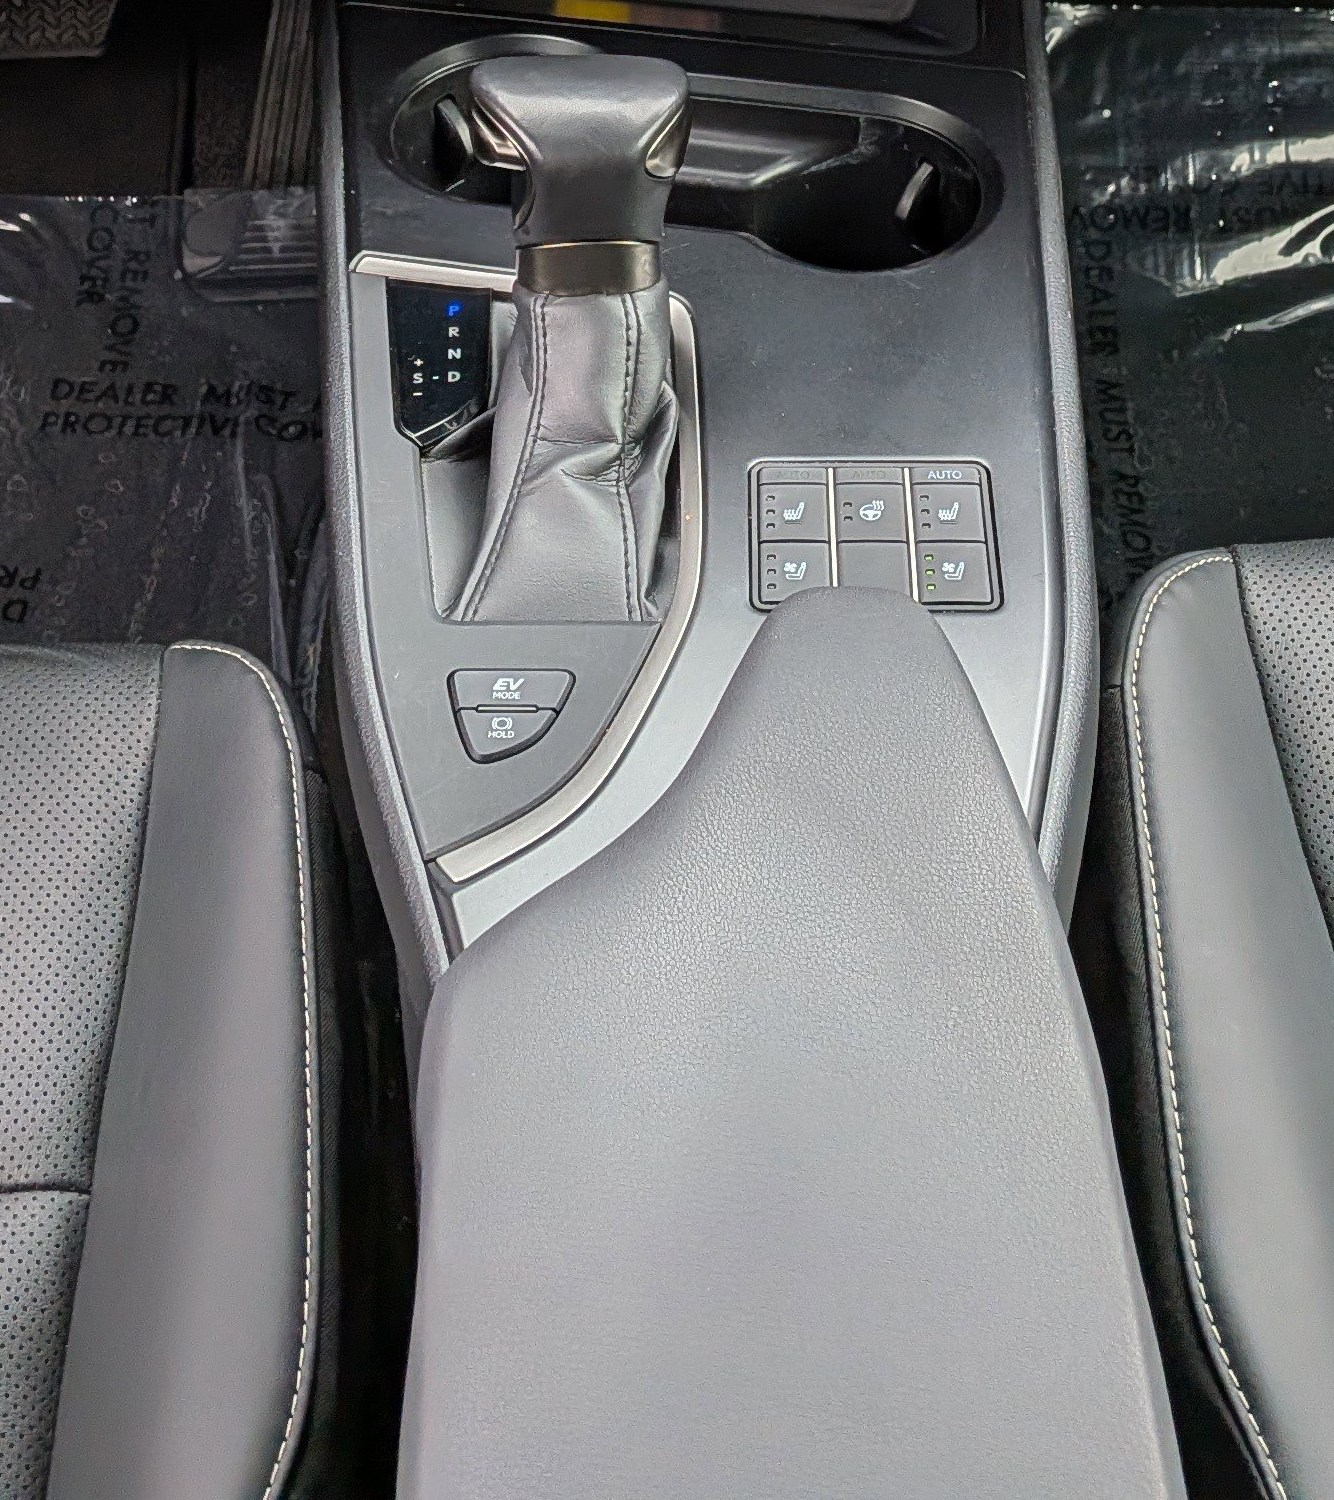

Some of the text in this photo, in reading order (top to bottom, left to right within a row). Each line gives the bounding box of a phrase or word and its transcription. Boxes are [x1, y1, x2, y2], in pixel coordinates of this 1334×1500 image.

[75, 204, 121, 308] COVER
[1084, 240, 1120, 357] DEALER
[98, 247, 152, 375] REMOVE
[448, 304, 461, 317] P
[448, 326, 460, 338] R
[447, 348, 462, 360] N
[412, 372, 424, 384] S
[447, 371, 461, 383] D
[49, 376, 177, 405] DEALER
[1095, 379, 1136, 458] MUST
[927, 469, 963, 481] AUTO
[492, 678, 525, 691] EV
[492, 691, 522, 700] MODE
[487, 730, 515, 739] HOLD
